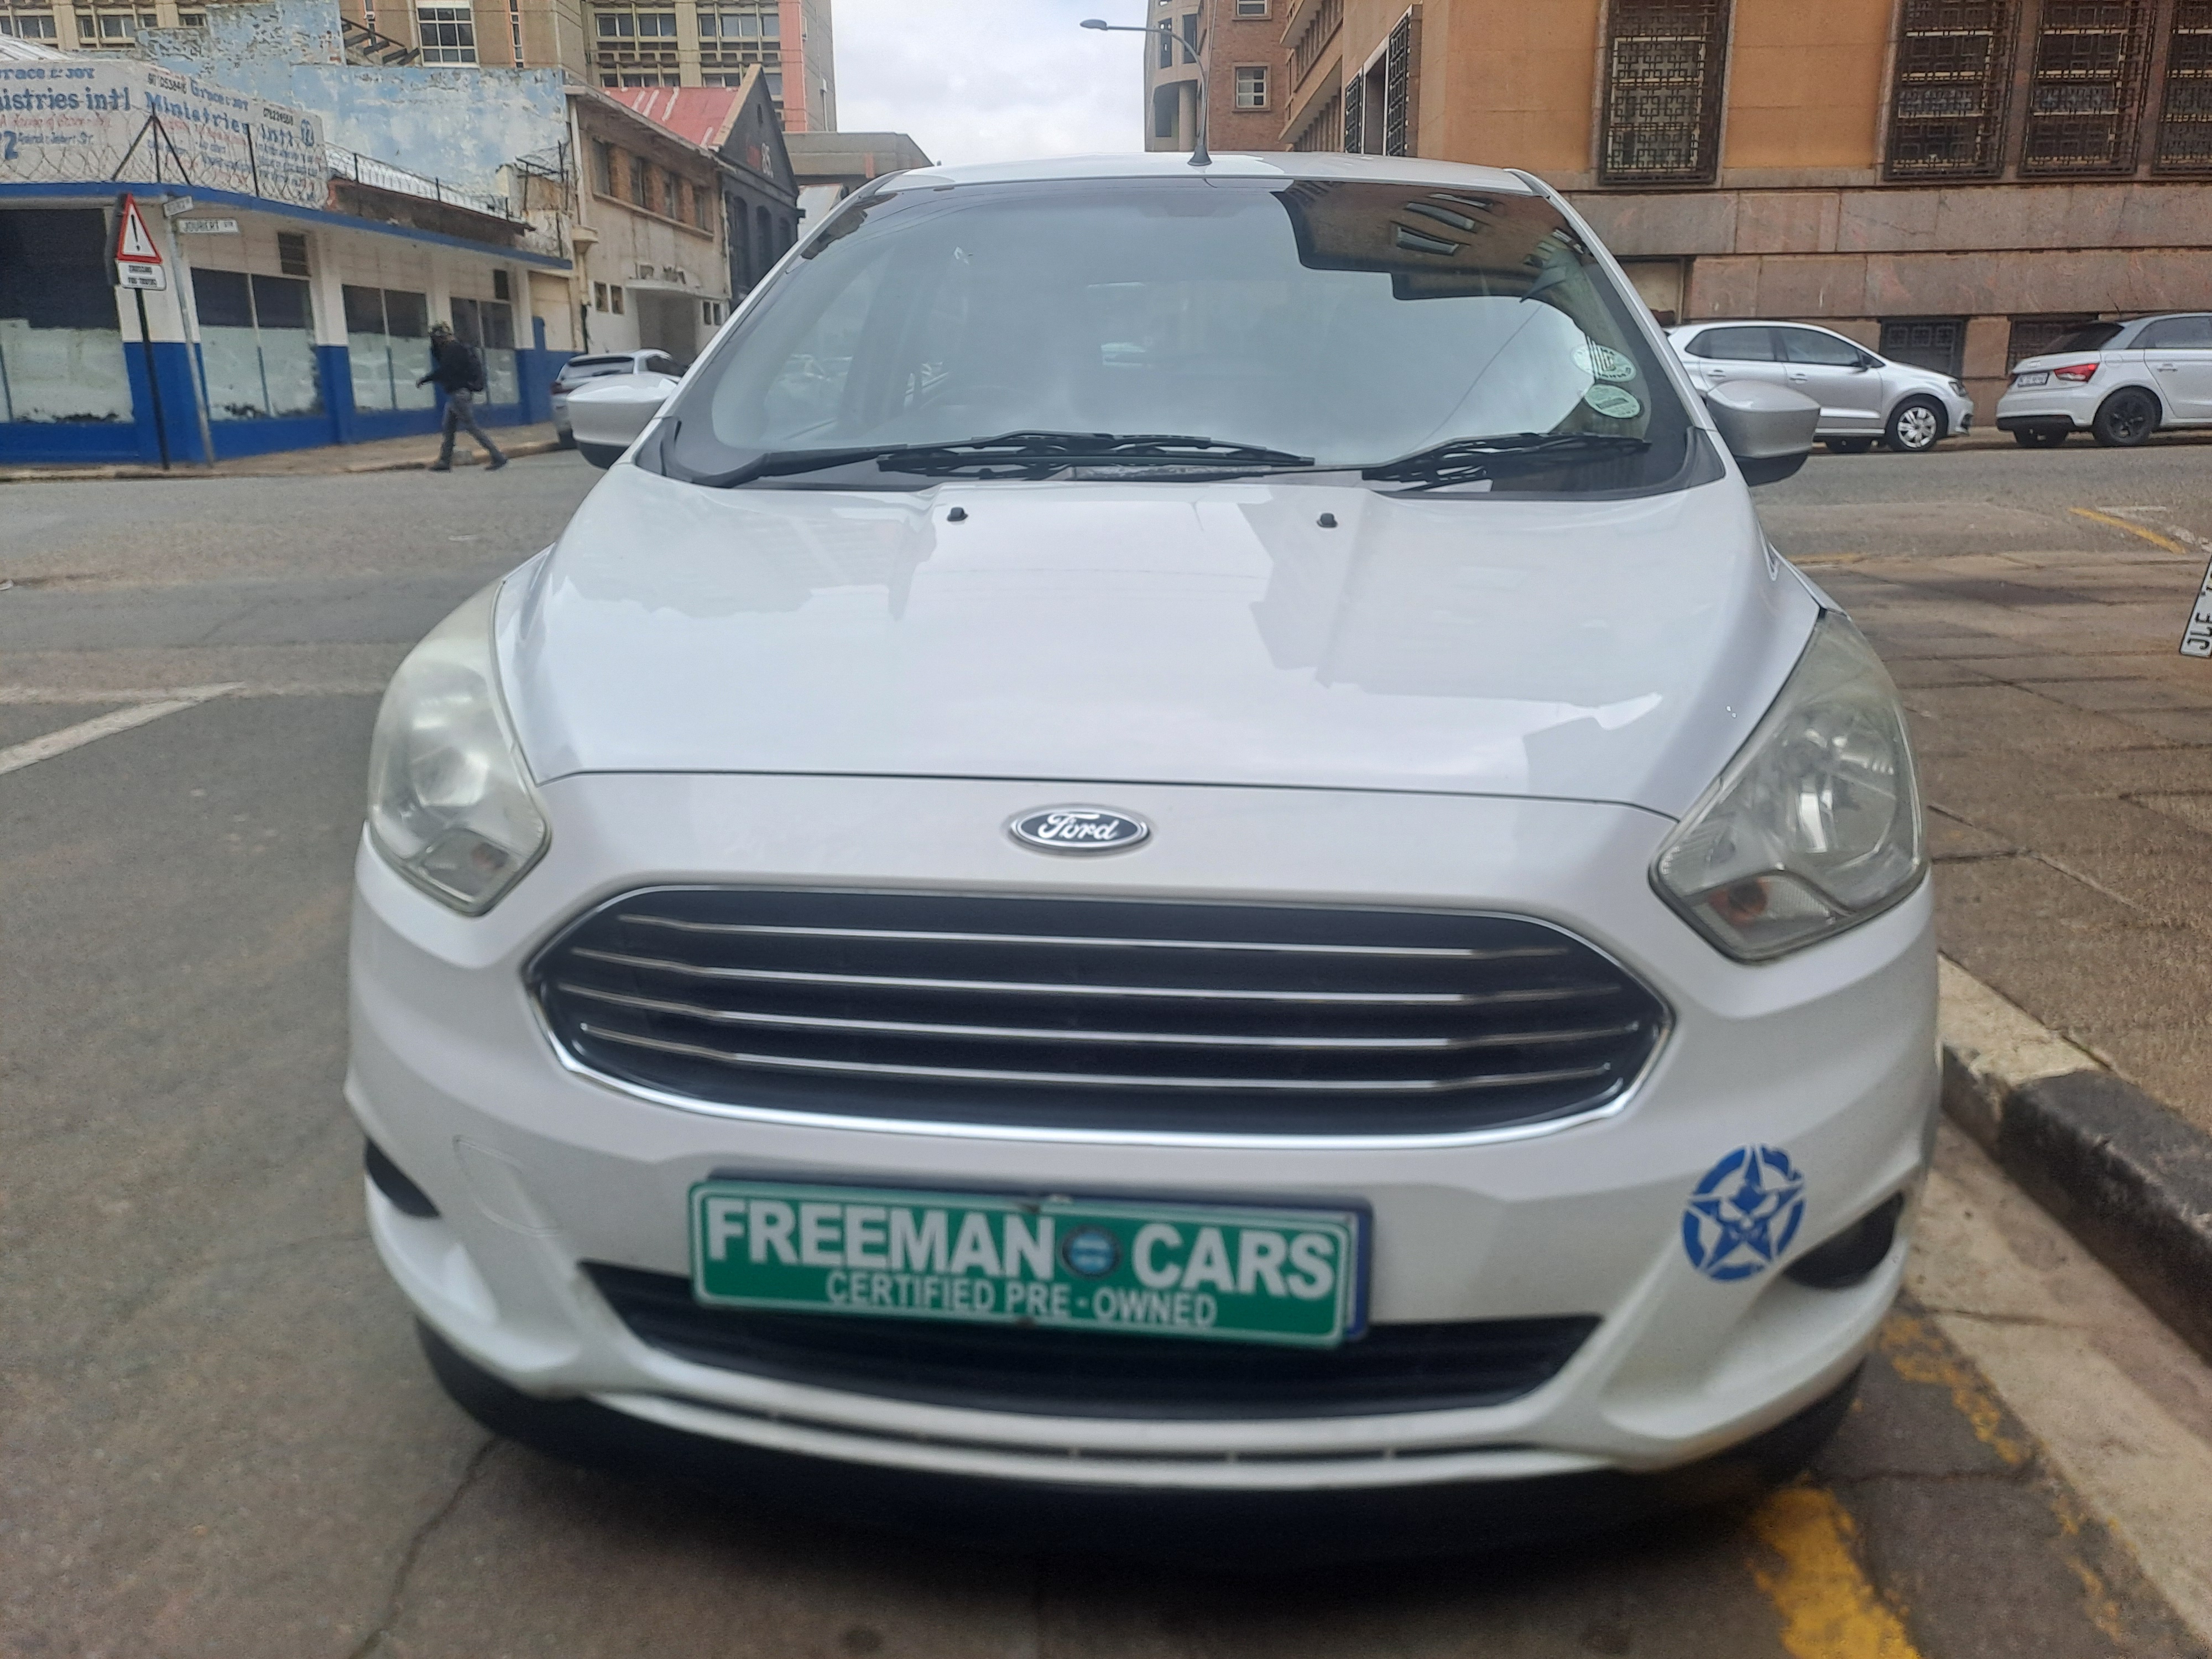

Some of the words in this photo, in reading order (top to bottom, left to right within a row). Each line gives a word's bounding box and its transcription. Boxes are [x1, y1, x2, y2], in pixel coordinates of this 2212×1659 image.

[0, 68, 45, 80] race
[0, 87, 80, 111] istries
[1037, 812, 1120, 840] Ford
[707, 1198, 1056, 1280] FREEMAN
[1132, 1223, 1336, 1300] CARS
[826, 1272, 995, 1312] CERTIFIED
